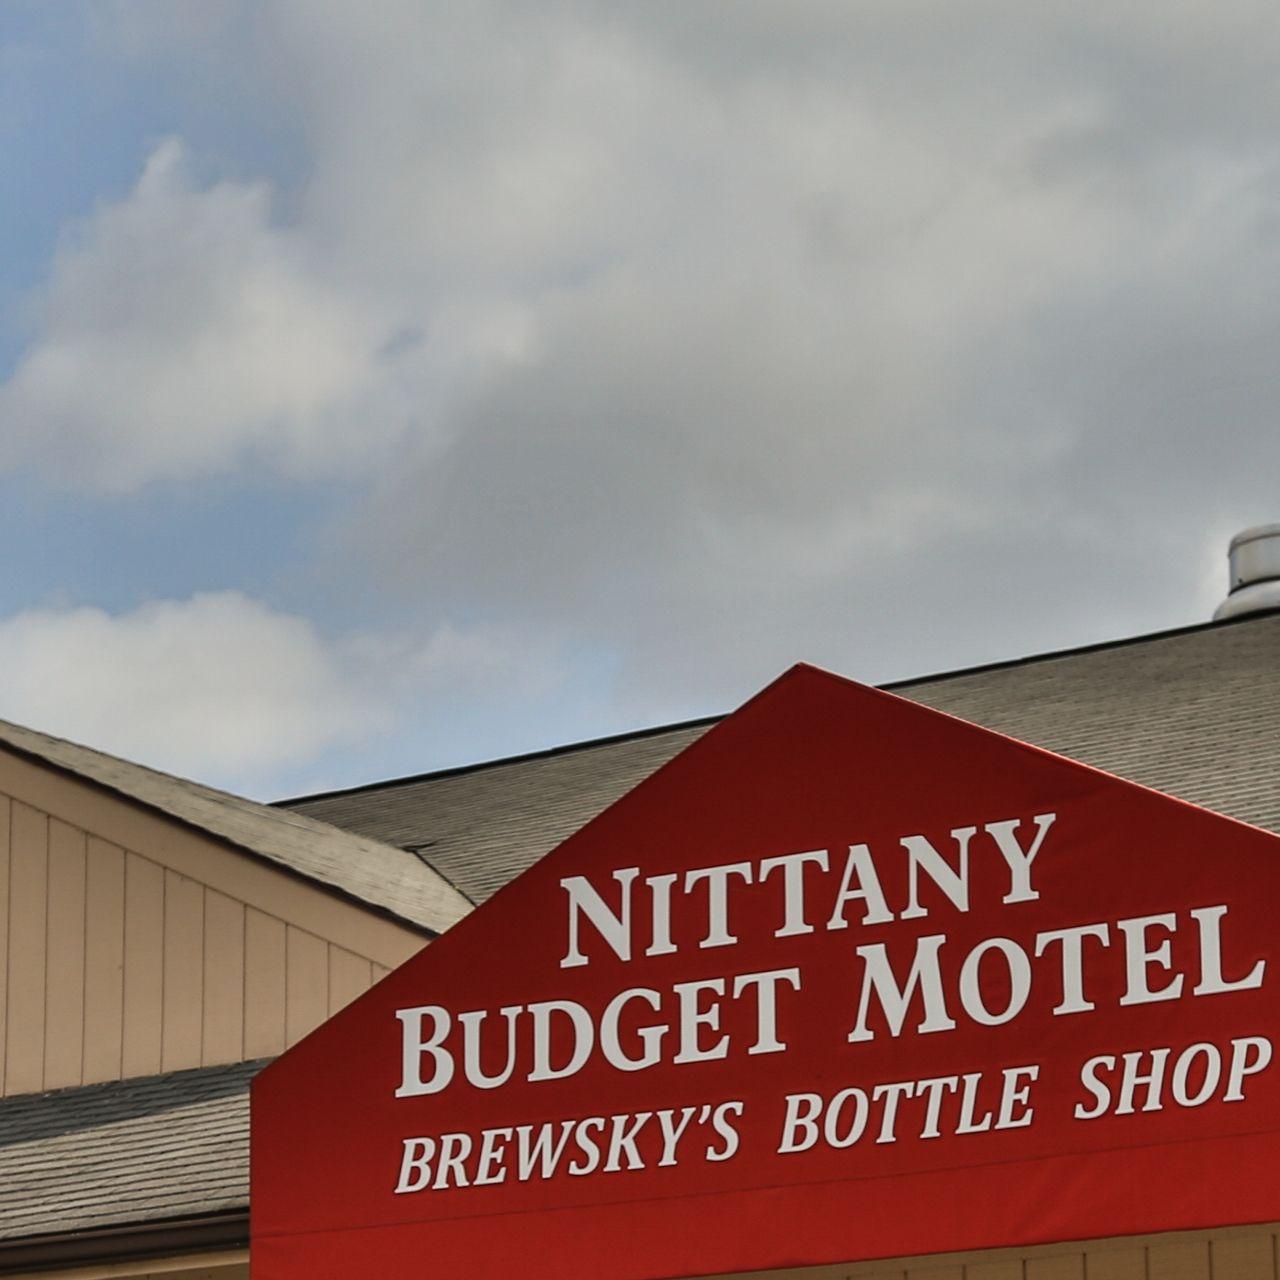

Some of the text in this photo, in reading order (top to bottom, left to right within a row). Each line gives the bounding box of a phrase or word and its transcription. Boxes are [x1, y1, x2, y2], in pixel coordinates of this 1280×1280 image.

[558, 813, 1057, 968] NITTANY
[394, 904, 1266, 1098] BUDGET MOTEL
[393, 1036, 1273, 1194] BREWSKY'S BOTTLE SHOP
